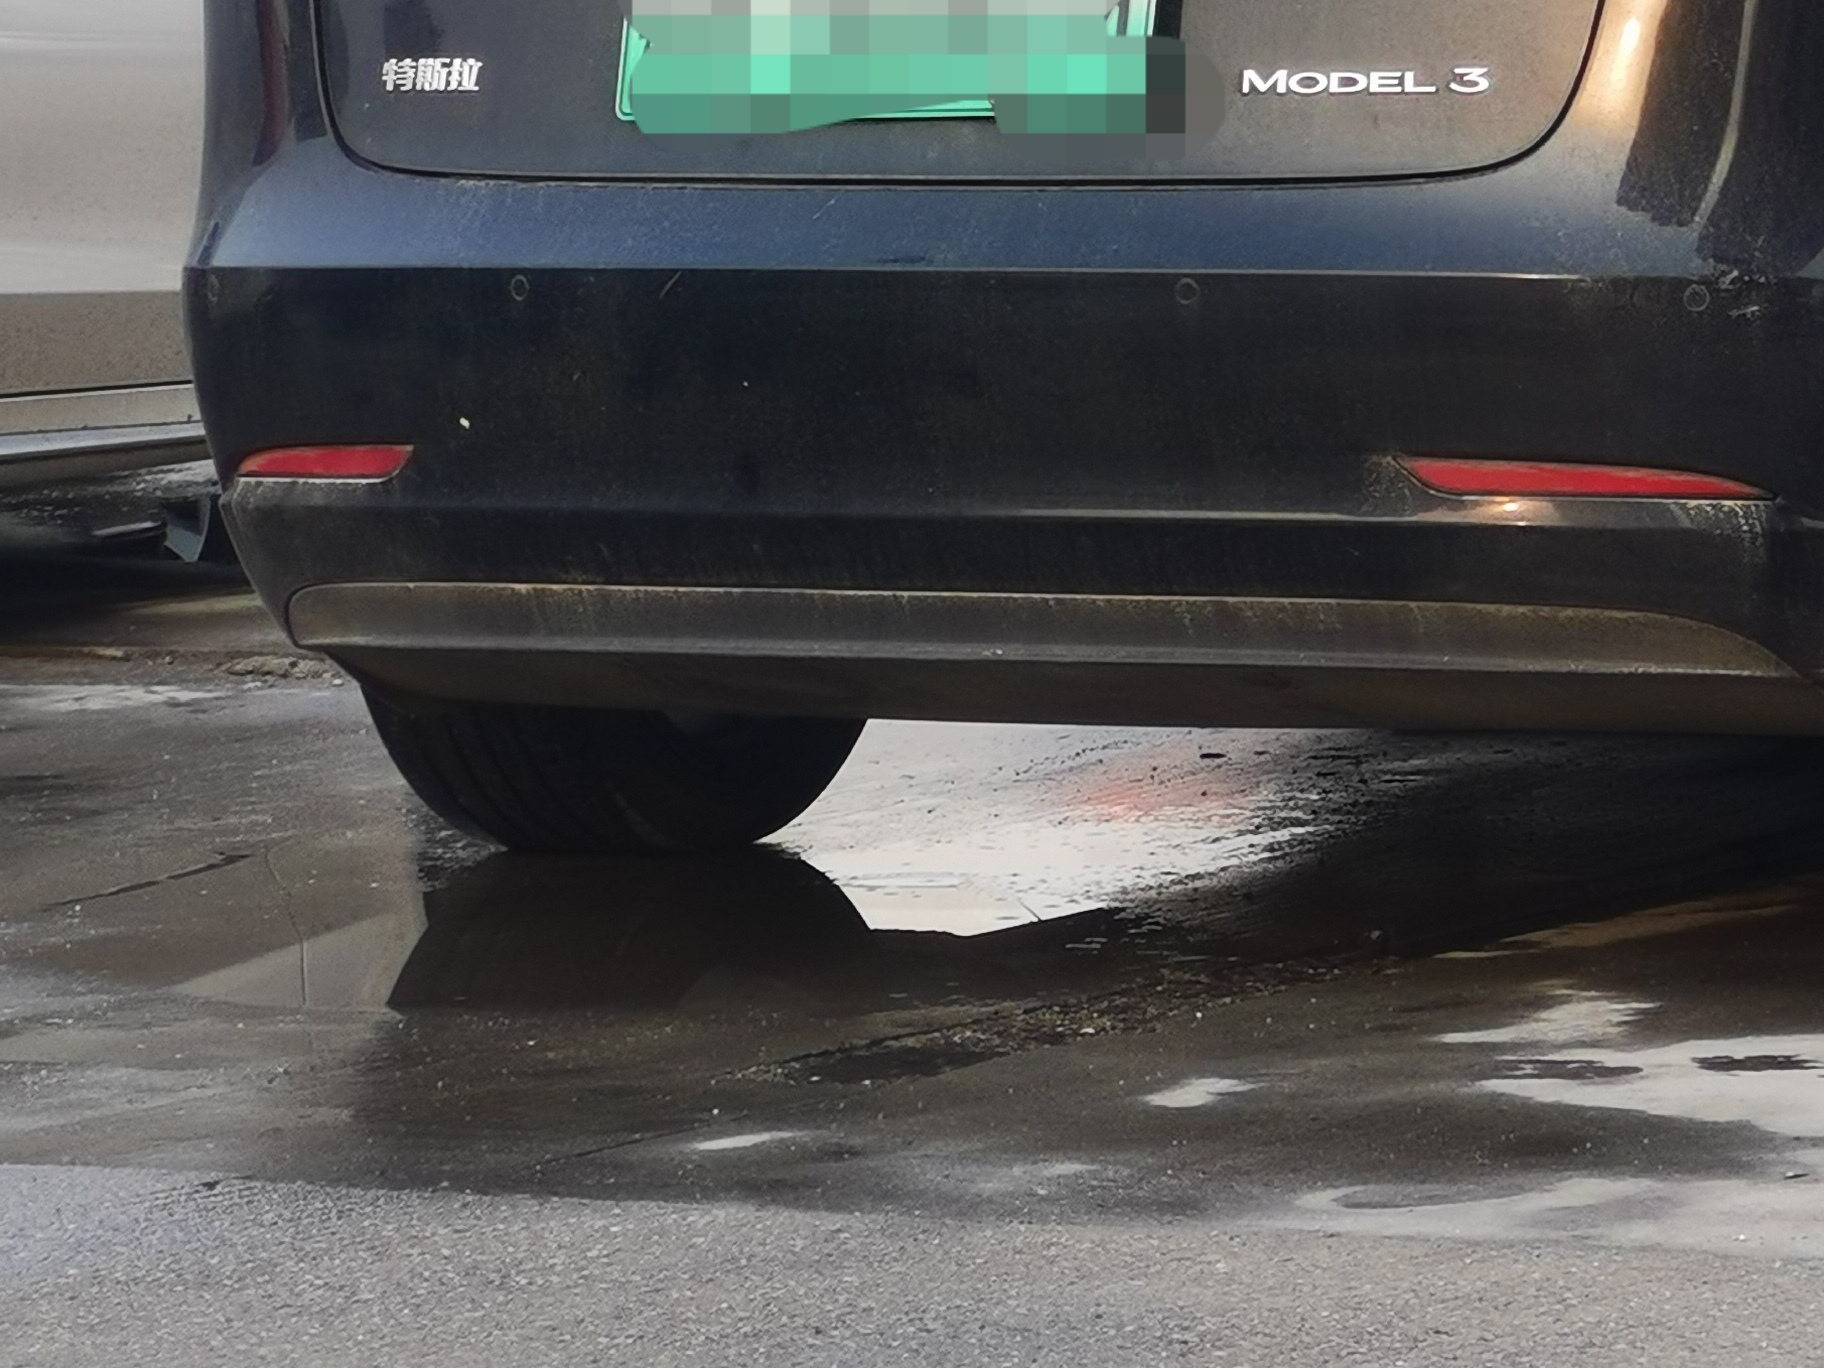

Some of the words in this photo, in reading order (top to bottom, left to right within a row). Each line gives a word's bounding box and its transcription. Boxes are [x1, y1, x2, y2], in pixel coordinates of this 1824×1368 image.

[381, 57, 484, 92] 特斯拉
[1241, 68, 1437, 95] MODEL
[1448, 66, 1490, 94] 3
